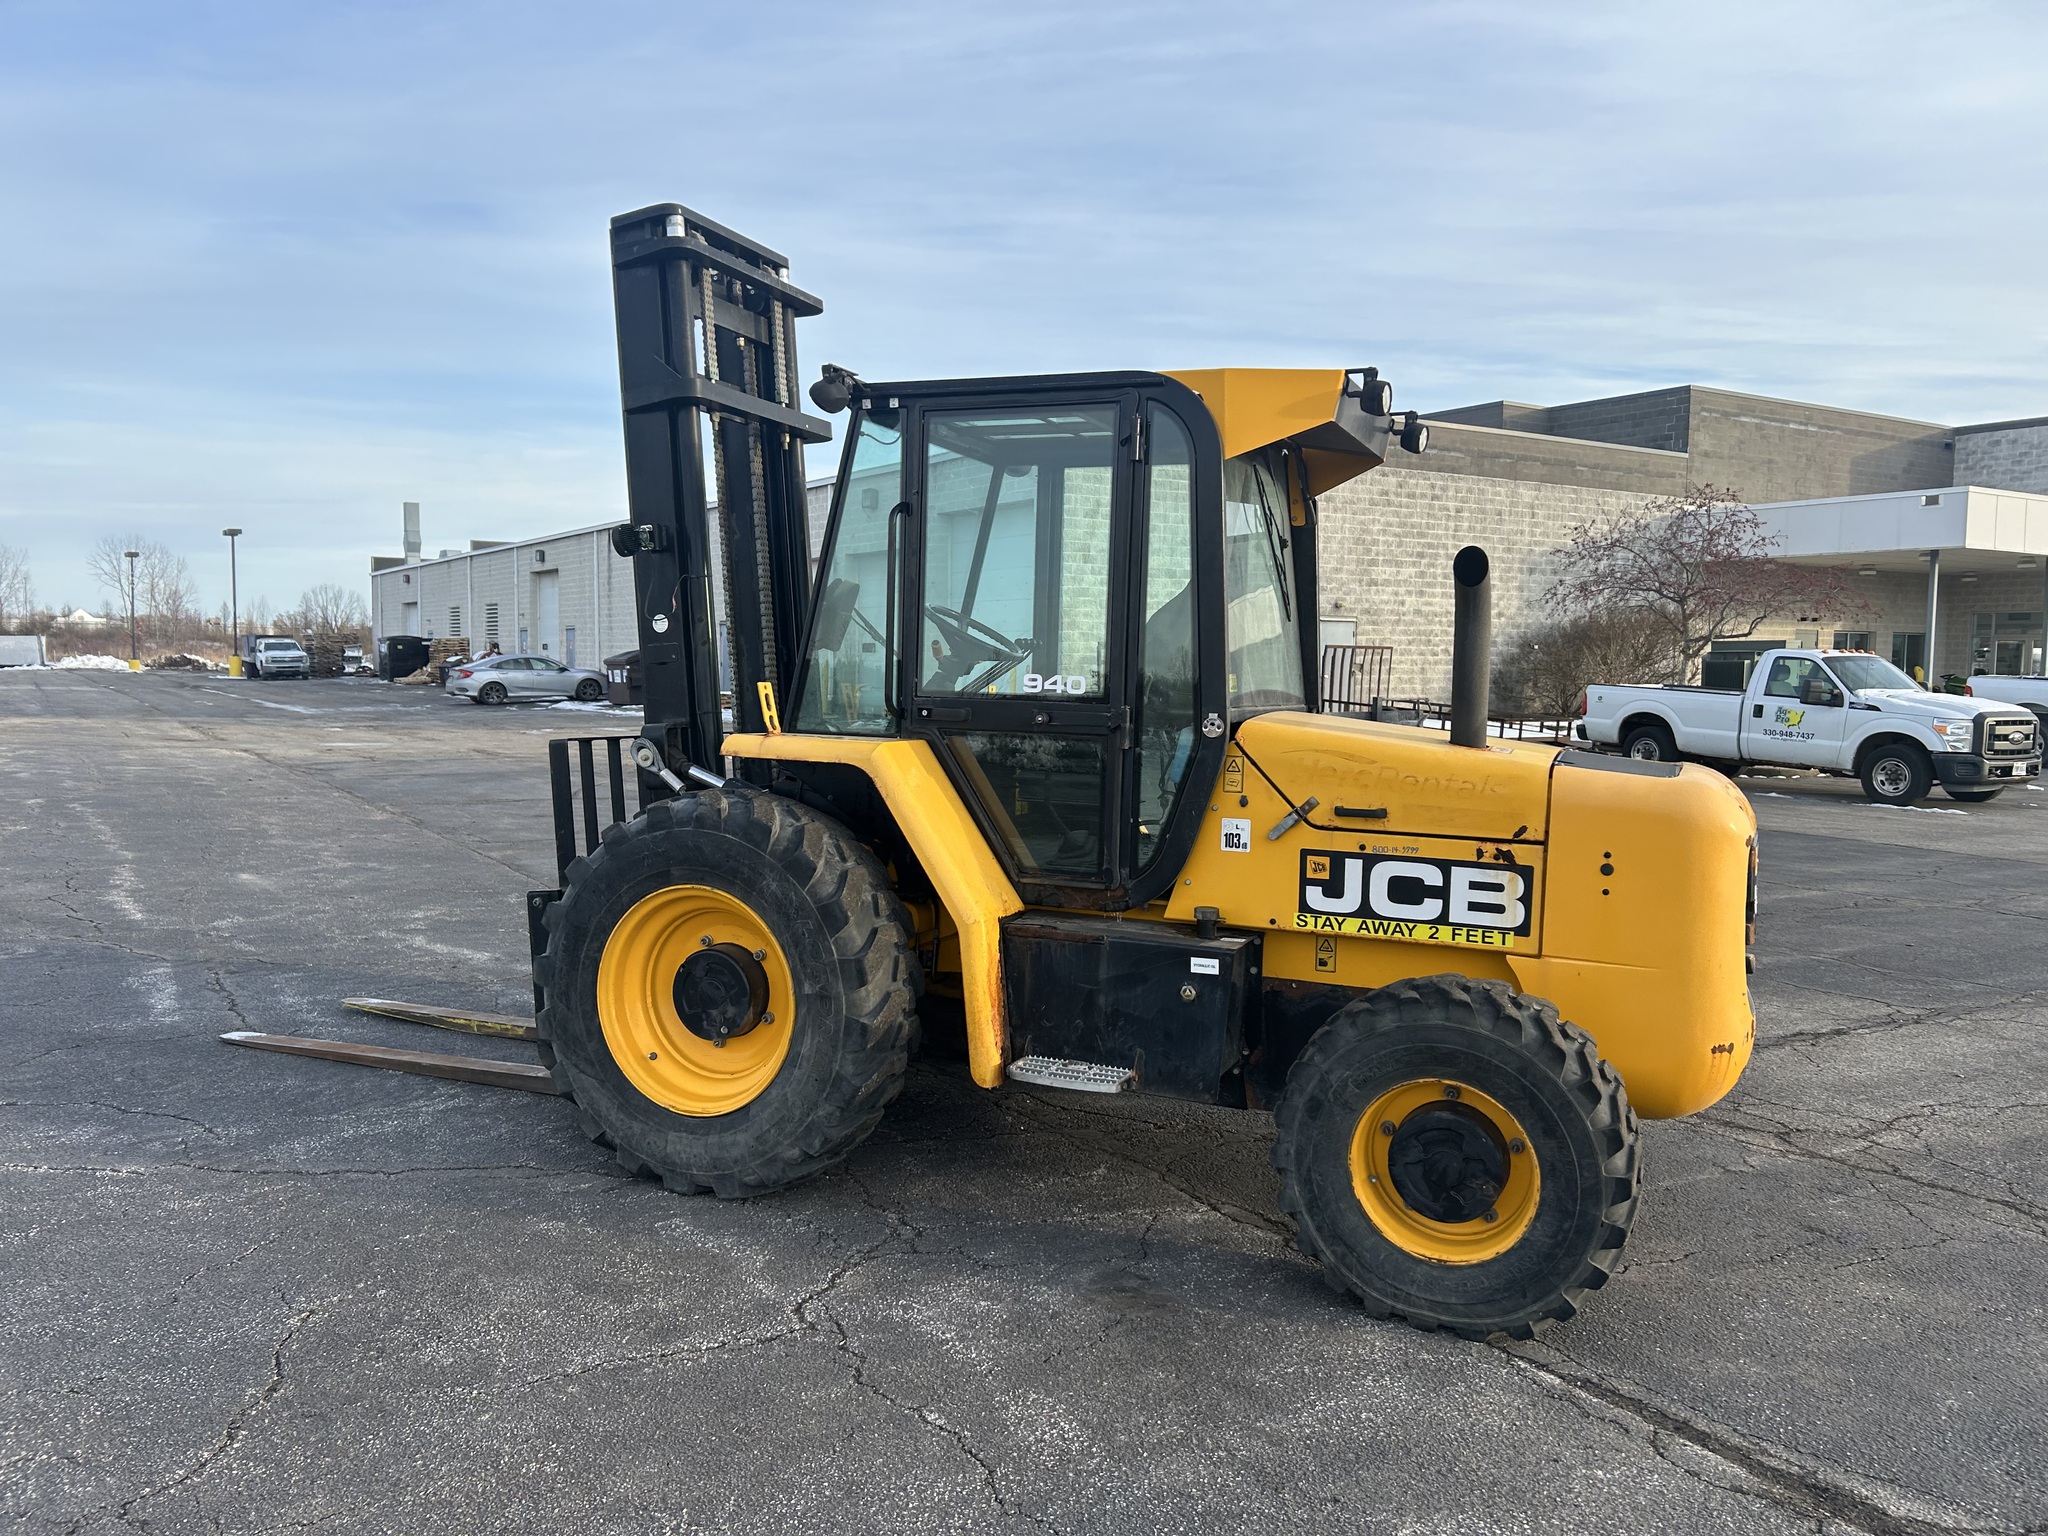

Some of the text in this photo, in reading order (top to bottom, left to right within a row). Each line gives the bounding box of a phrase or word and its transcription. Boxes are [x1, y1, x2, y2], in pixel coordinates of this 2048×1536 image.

[1023, 674, 1086, 694] 940
[1775, 715, 1790, 723] Pro
[1762, 729, 1815, 740] 330-948-7437
[1224, 832, 1240, 848] 103
[1306, 858, 1525, 928] JCB
[1296, 914, 1511, 945] STAY AWAY 2 FEET
